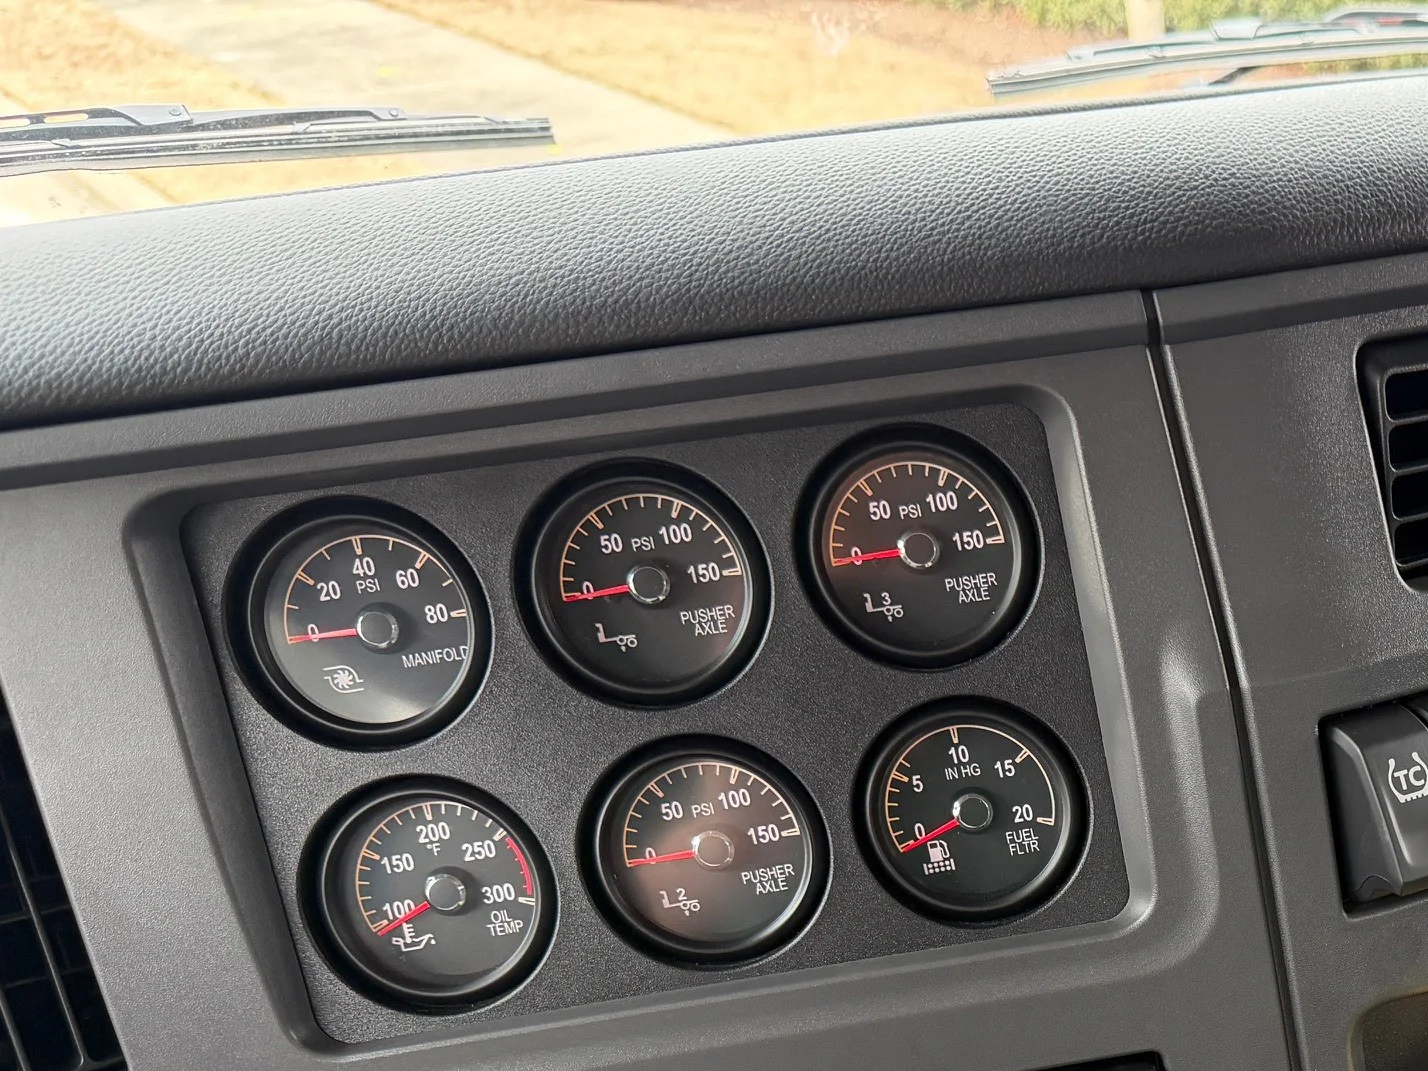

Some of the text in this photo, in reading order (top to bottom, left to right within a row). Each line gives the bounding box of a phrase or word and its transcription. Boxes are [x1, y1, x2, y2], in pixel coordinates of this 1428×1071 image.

[869, 500, 891, 521] 50
[899, 503, 922, 520] PSI
[926, 491, 958, 513] 100
[600, 533, 623, 554] 50
[631, 536, 655, 552] PSI
[658, 523, 692, 545] 100
[953, 530, 984, 551] 150
[851, 547, 863, 565] 0
[352, 556, 375, 577] 40
[687, 562, 720, 584] 150
[356, 578, 380, 594] PSI
[396, 568, 420, 589] 60
[945, 572, 998, 591] PUSHER
[317, 580, 341, 601] 20
[958, 586, 990, 604] AXLE
[424, 603, 449, 624] 80
[680, 605, 735, 625] PUSHER
[307, 623, 320, 642] 0
[695, 619, 728, 637] AXLE
[402, 646, 469, 668] MANIFOLD
[948, 745, 969, 764] 10
[945, 763, 981, 780] IN HG
[994, 759, 1015, 778] 15
[1393, 765, 1425, 791] TC
[912, 775, 923, 793] 5
[718, 788, 751, 810] 100
[661, 801, 683, 821] 50
[692, 802, 715, 818] PSI
[1012, 803, 1033, 823] 20
[416, 821, 451, 844] 200
[747, 823, 780, 845] 150
[914, 823, 926, 840] 0
[1005, 828, 1039, 844] FUEL
[462, 840, 496, 862] 250
[645, 847, 657, 864] 0
[1009, 840, 1040, 856] FLTR
[381, 853, 414, 874] 150
[741, 863, 795, 884] PUSHER
[481, 883, 516, 905] 300
[756, 877, 788, 895] AXLE
[383, 899, 416, 920] 100
[490, 910, 513, 924] OIL
[486, 919, 524, 937] TEMP
